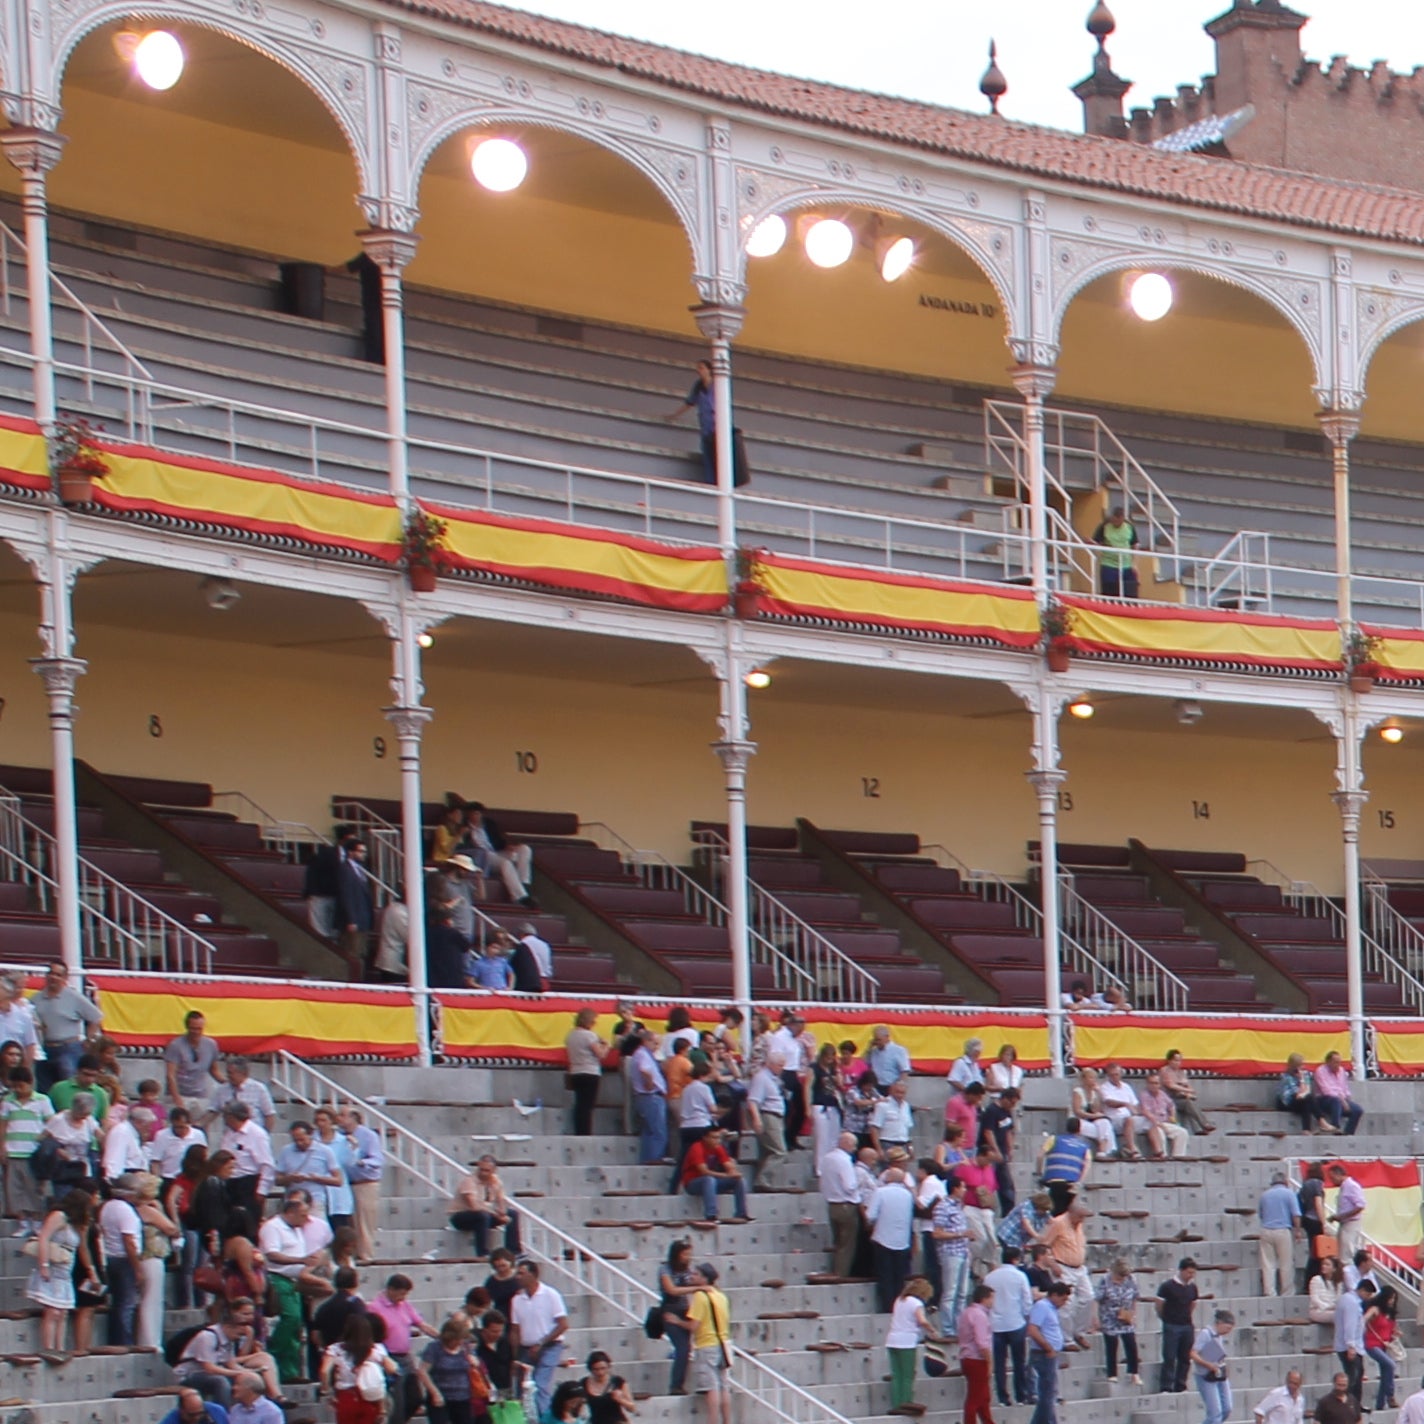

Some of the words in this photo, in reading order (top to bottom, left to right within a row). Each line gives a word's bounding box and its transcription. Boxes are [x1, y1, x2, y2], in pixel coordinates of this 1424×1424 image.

[148, 714, 163, 738] 8
[373, 737, 386, 758] 9
[515, 751, 538, 773] 10
[861, 777, 881, 799] 12
[1057, 792, 1074, 811] 13
[1192, 800, 1210, 820] 14
[1378, 809, 1396, 830] 15
